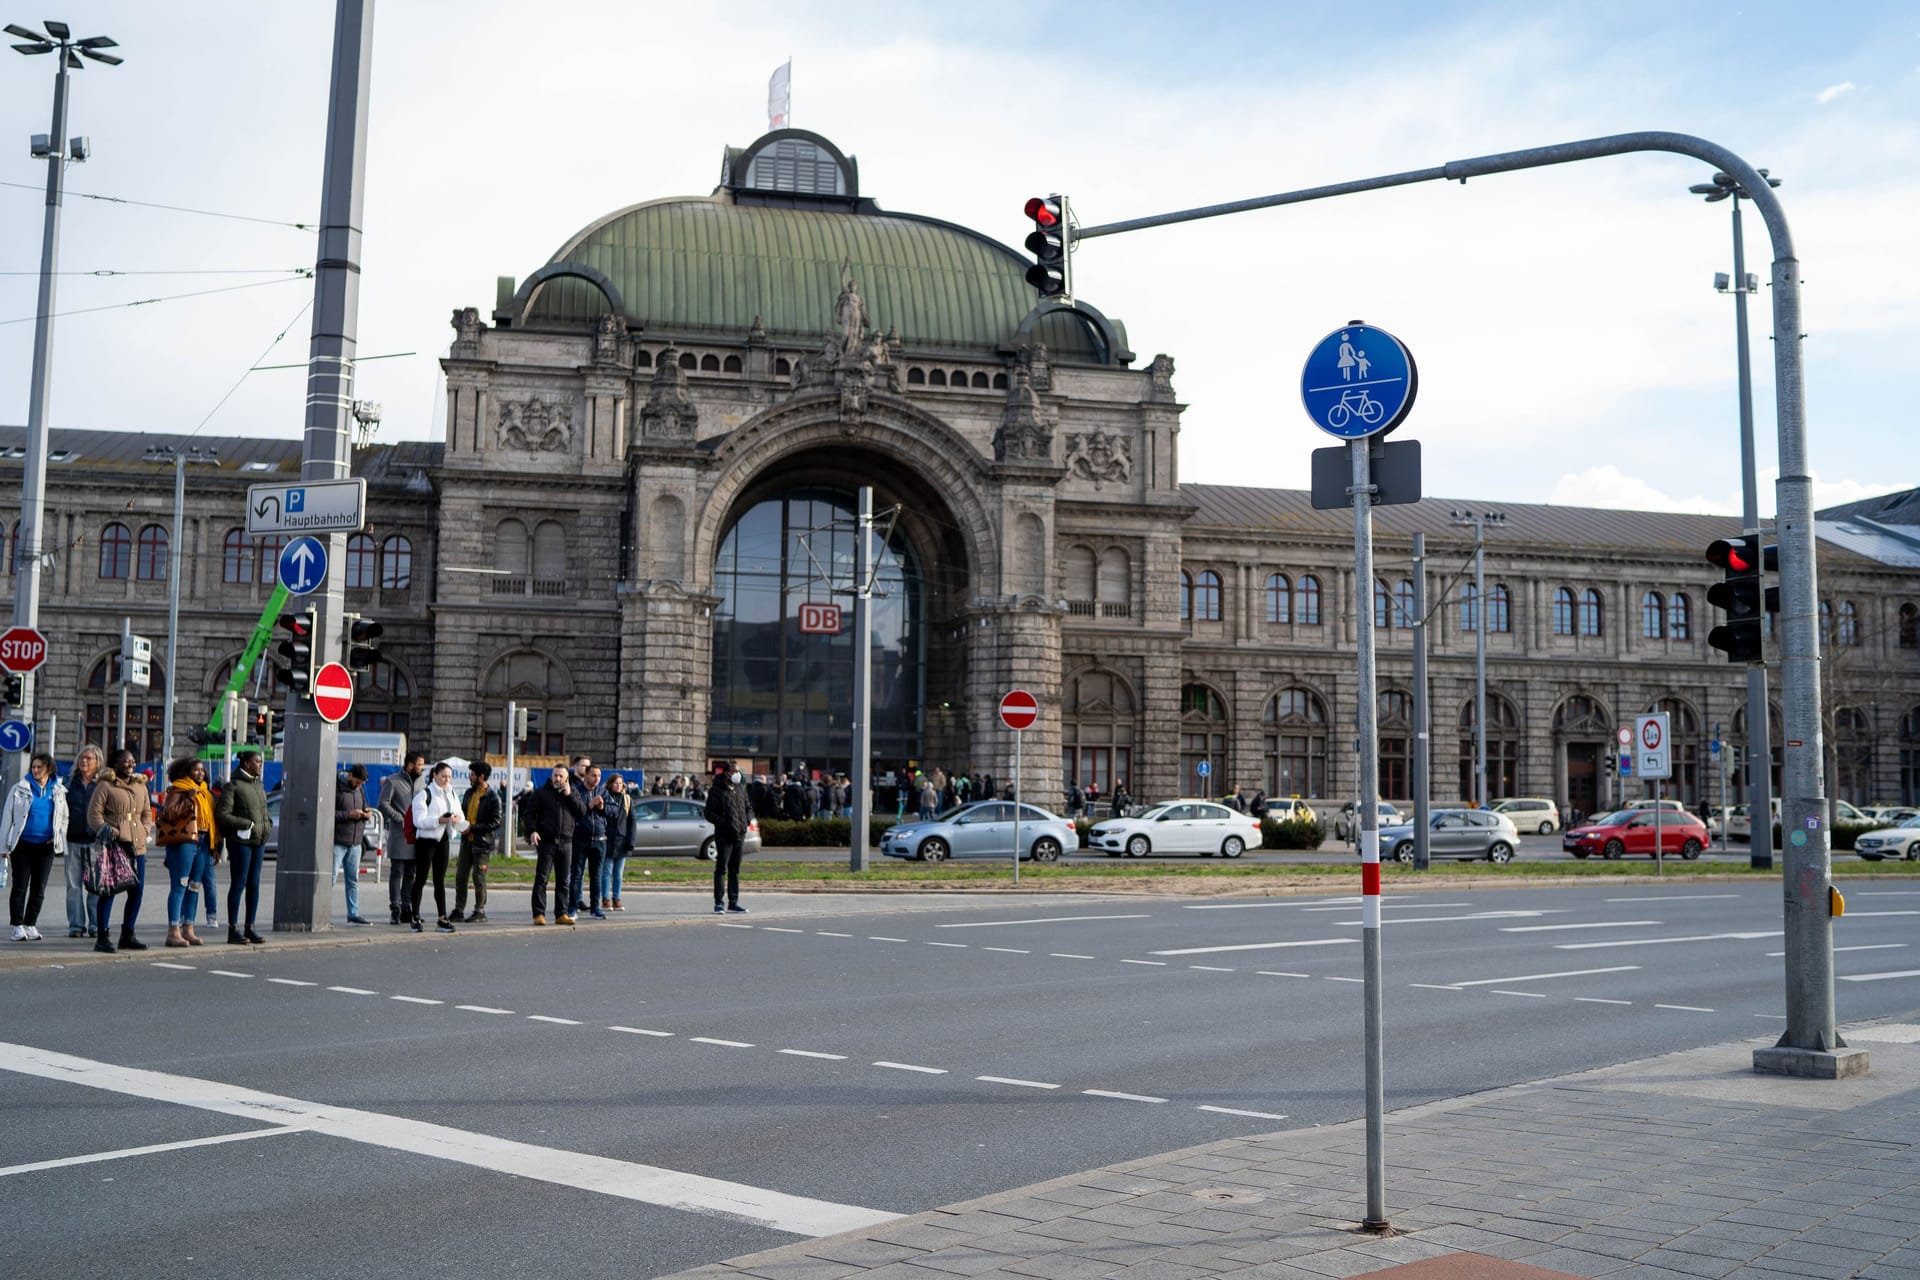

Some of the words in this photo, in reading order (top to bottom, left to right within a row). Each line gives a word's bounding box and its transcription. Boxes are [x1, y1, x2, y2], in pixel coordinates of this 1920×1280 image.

[289, 491, 301, 510] P
[284, 512, 356, 529] Hauptbahnhof
[806, 608, 837, 628] DB
[1, 640, 42, 660] STOP
